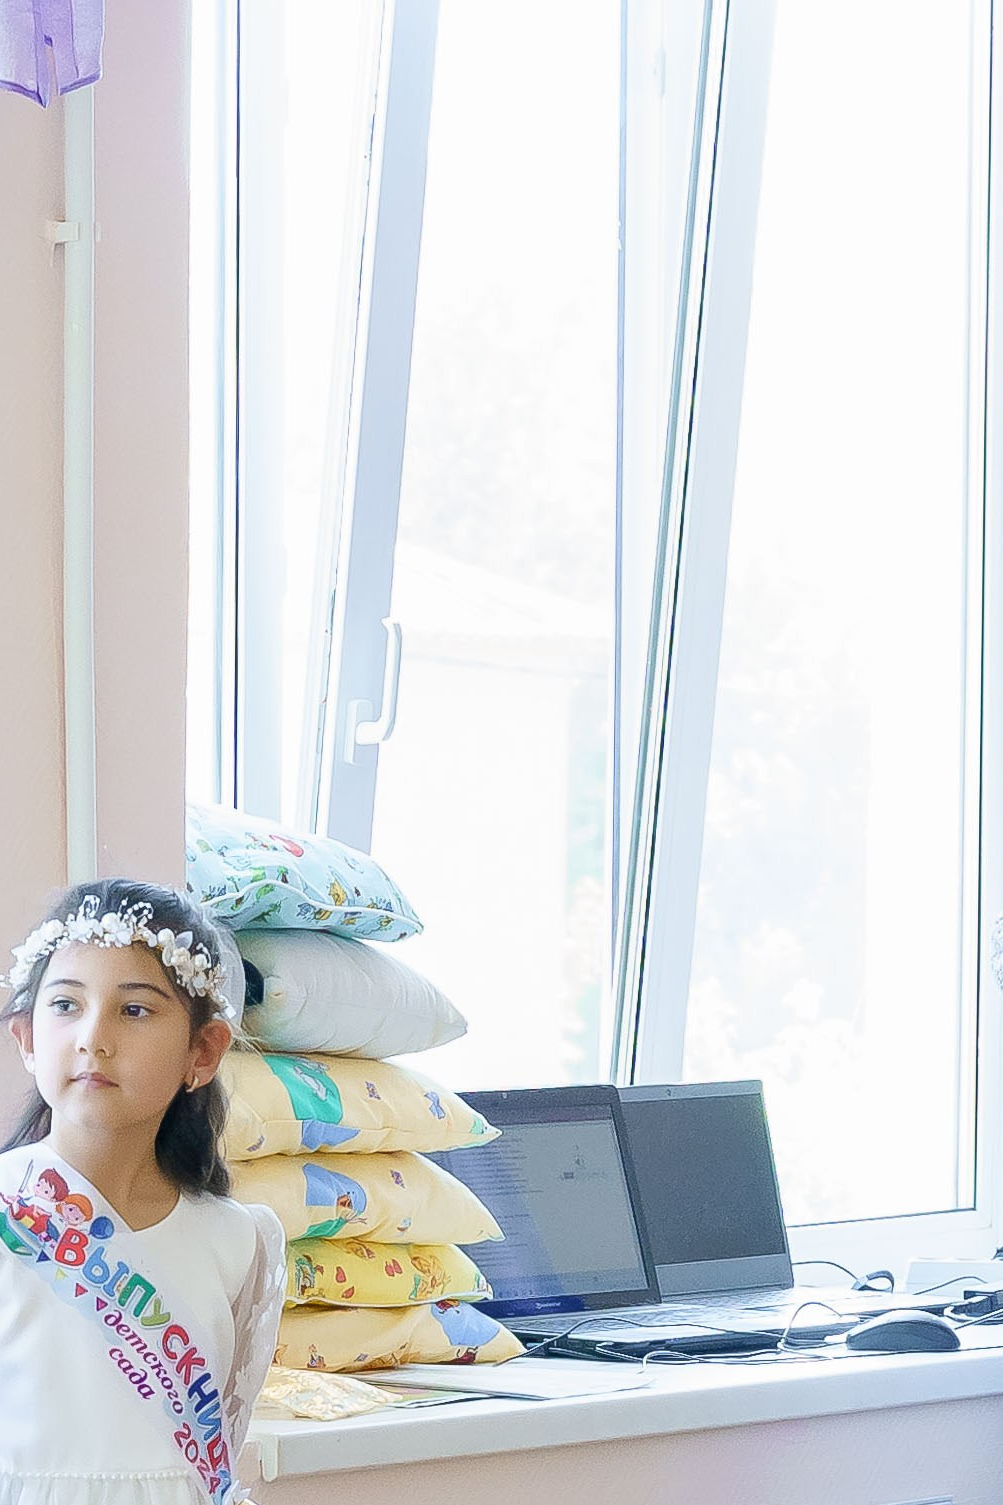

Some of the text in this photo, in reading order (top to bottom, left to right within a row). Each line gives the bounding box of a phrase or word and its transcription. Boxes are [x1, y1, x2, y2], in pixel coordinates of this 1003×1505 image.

[105, 1309, 184, 1414] детского
[109, 1348, 156, 1400] сада
[174, 1422, 221, 1494] 2024
